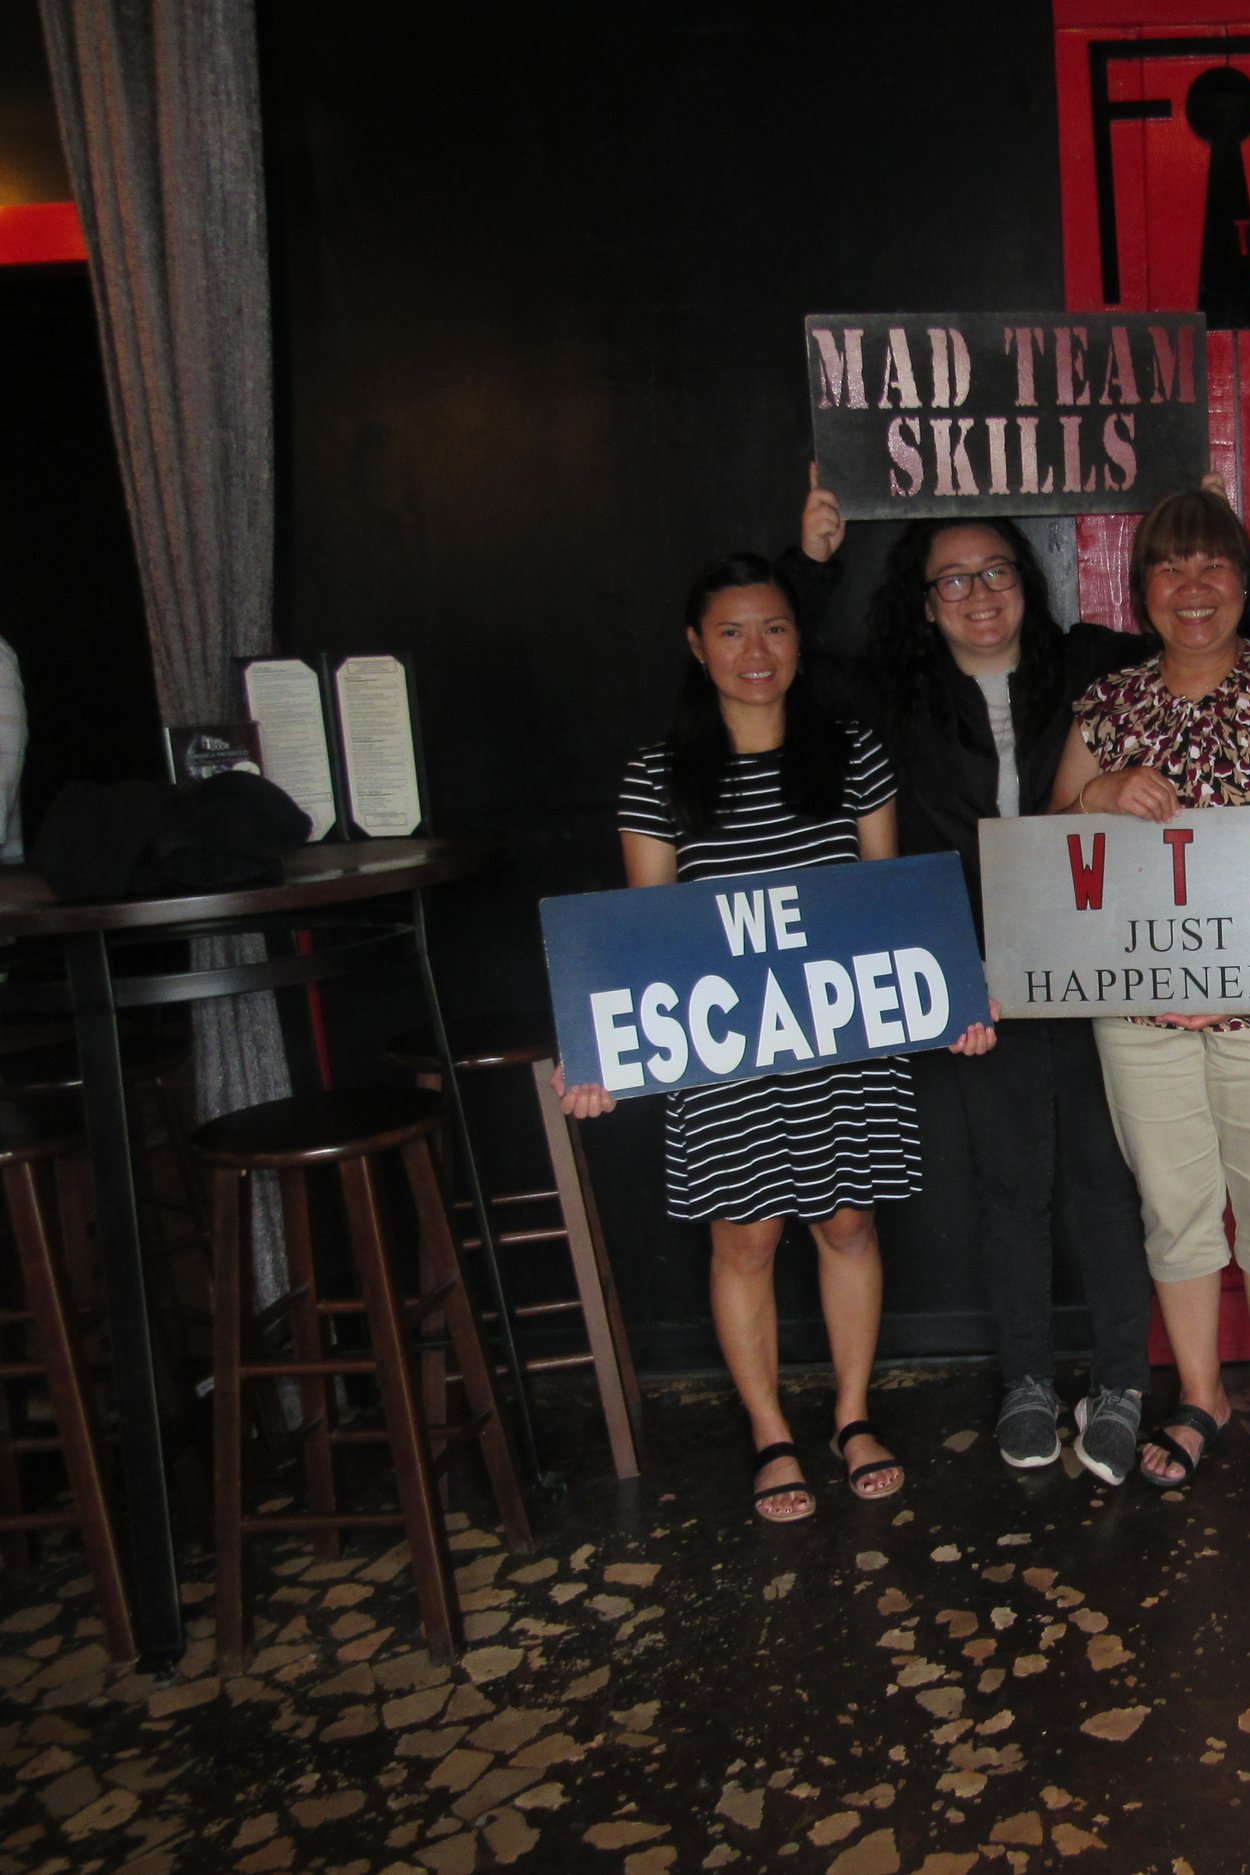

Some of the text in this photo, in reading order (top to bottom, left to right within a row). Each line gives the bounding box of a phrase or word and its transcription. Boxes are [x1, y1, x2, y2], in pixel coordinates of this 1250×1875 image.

[812, 326, 1196, 409] MAD TEAM
[887, 413, 1137, 497] SKILLS
[715, 885, 808, 957] WE
[1125, 917, 1233, 953] JUST
[590, 947, 950, 1092] ESCAPED
